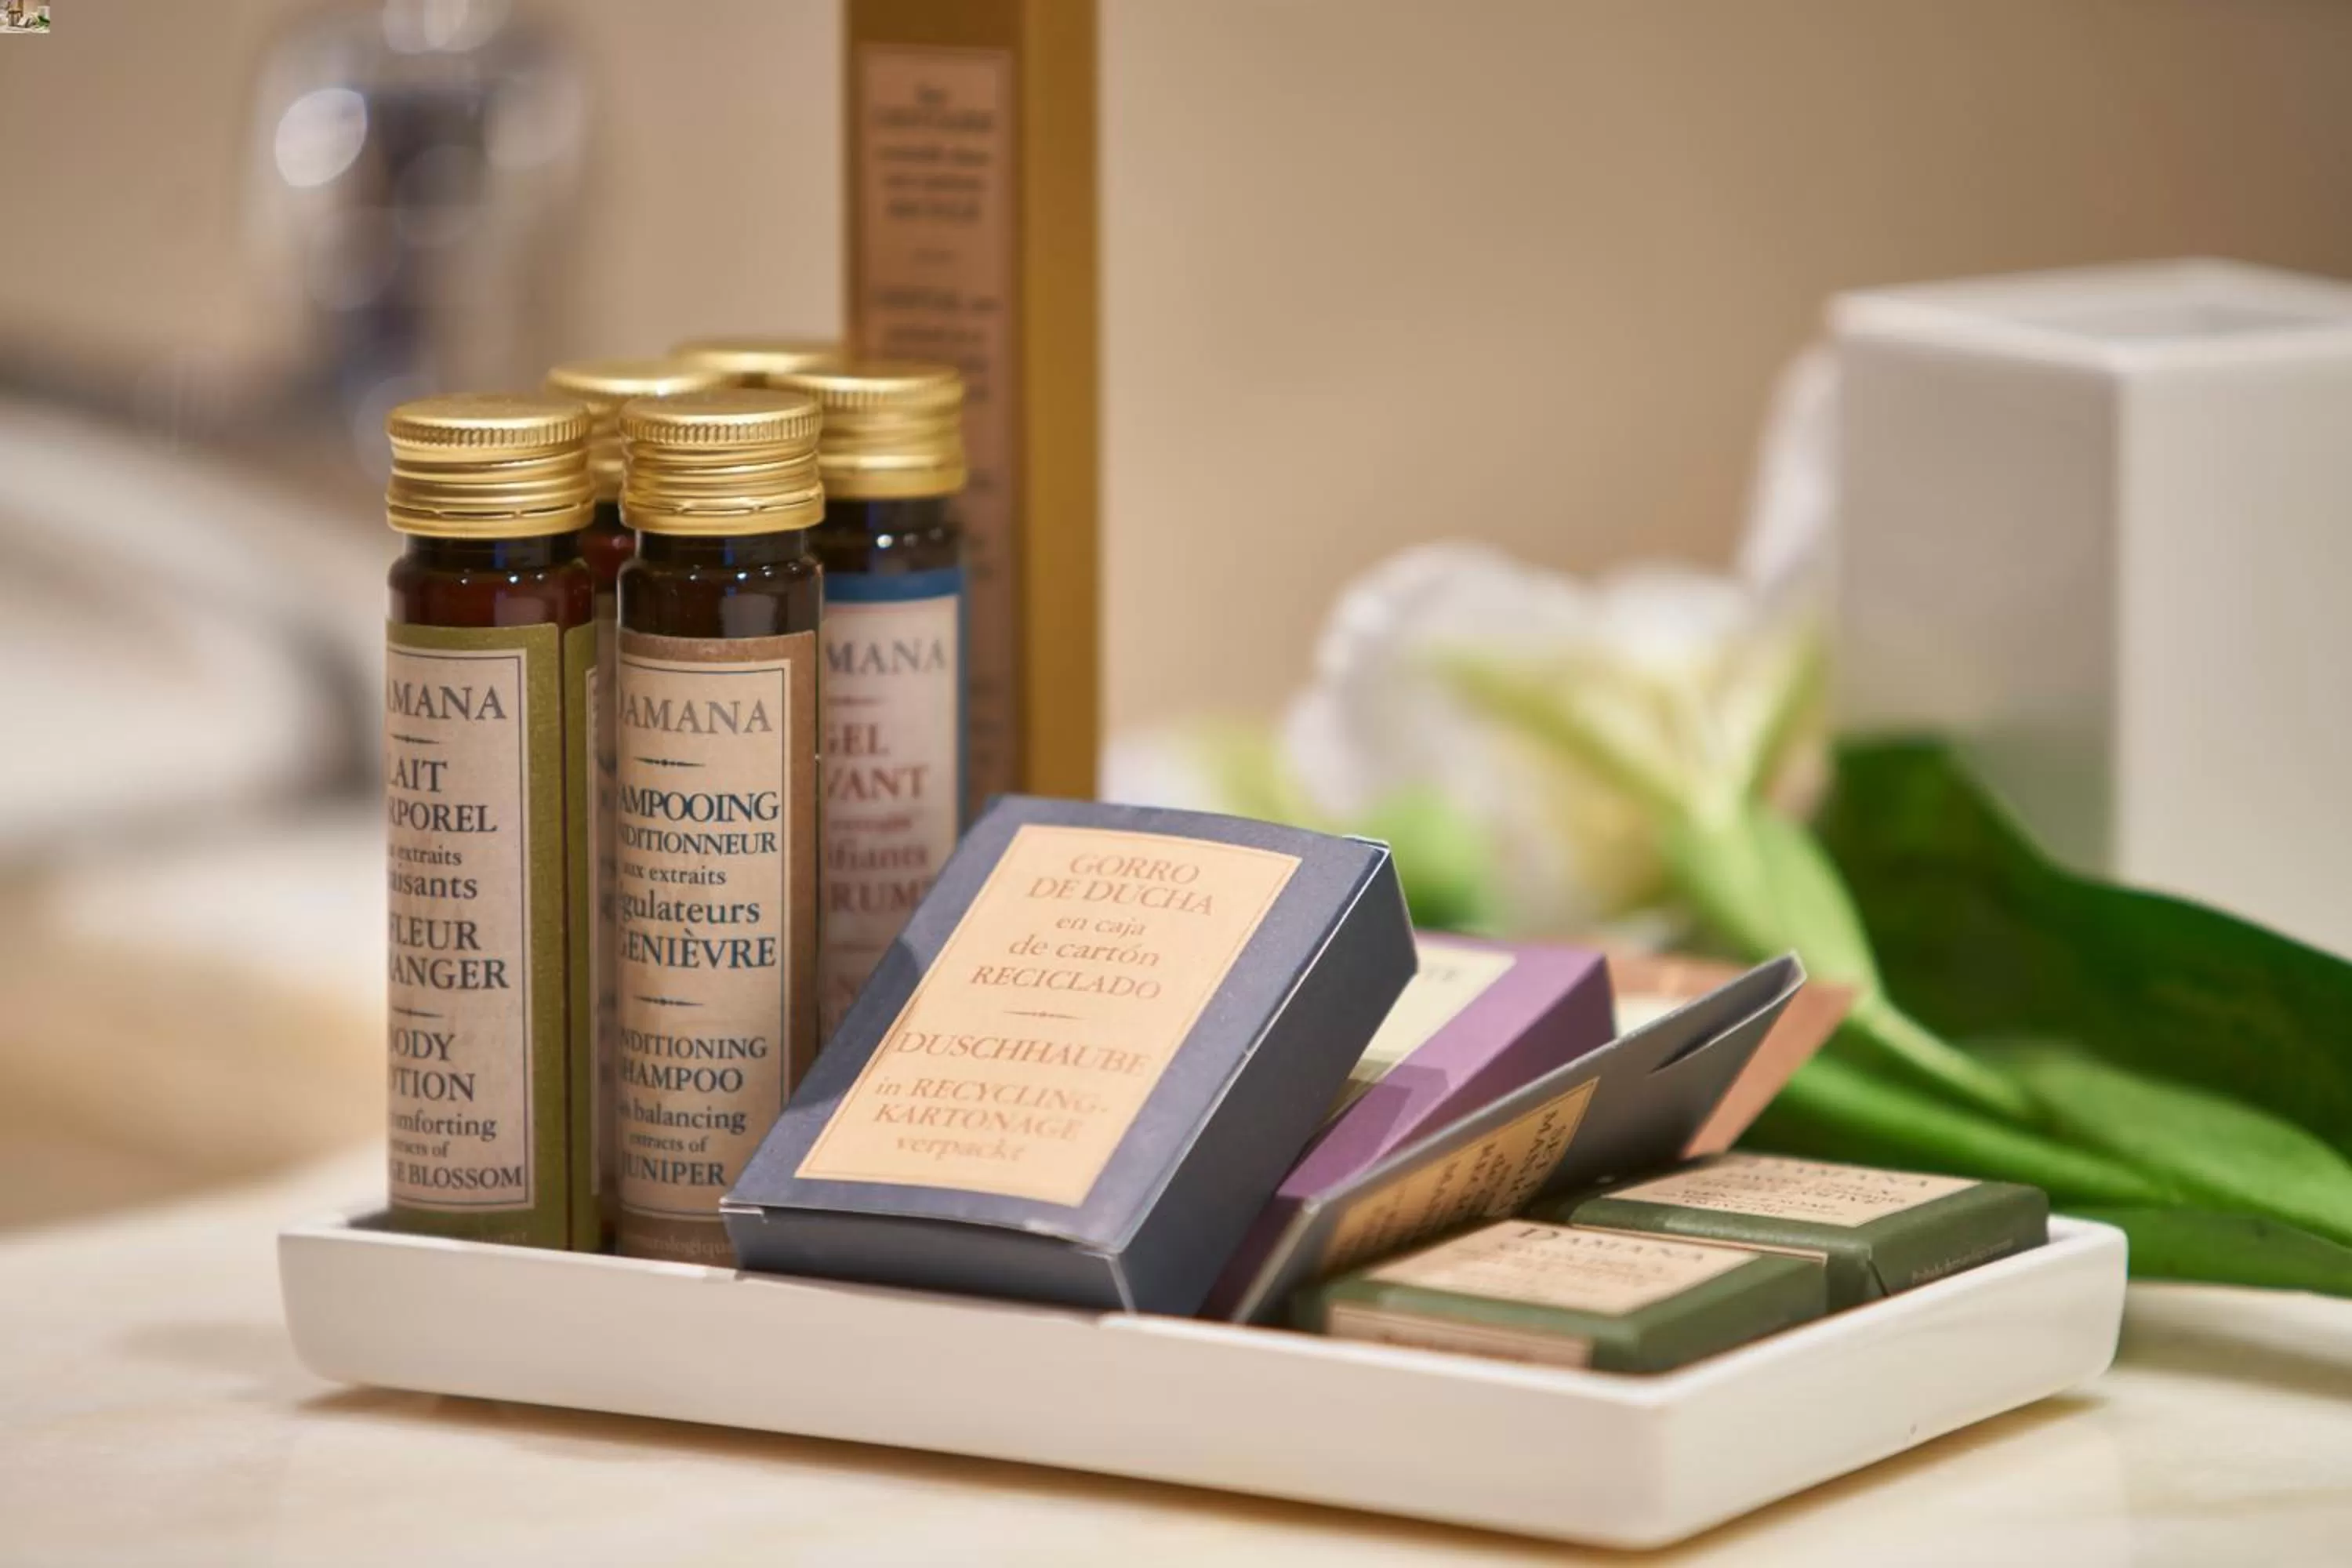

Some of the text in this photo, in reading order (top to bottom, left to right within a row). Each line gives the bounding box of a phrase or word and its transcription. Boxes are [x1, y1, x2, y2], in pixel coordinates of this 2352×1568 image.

[389, 754, 448, 793] AIT
[649, 865, 728, 886] extraits
[1069, 851, 1201, 885] GORRO
[620, 883, 761, 926] gulateurs
[1027, 876, 1214, 916] DE DUCHA
[1054, 916, 1147, 938] en caja
[1007, 933, 1161, 968] de cartón
[969, 965, 1163, 1001] RECICLADO
[895, 1031, 1154, 1077] DUSCHHAUBE
[874, 1076, 903, 1097] in
[390, 1108, 498, 1142] mforting
[633, 1097, 747, 1135] balancing
[872, 1103, 1087, 1142] KARTONAGE
[688, 1135, 710, 1154] of
[895, 1134, 1029, 1164] verpackt
[408, 1163, 524, 1190] BLOSSOM
